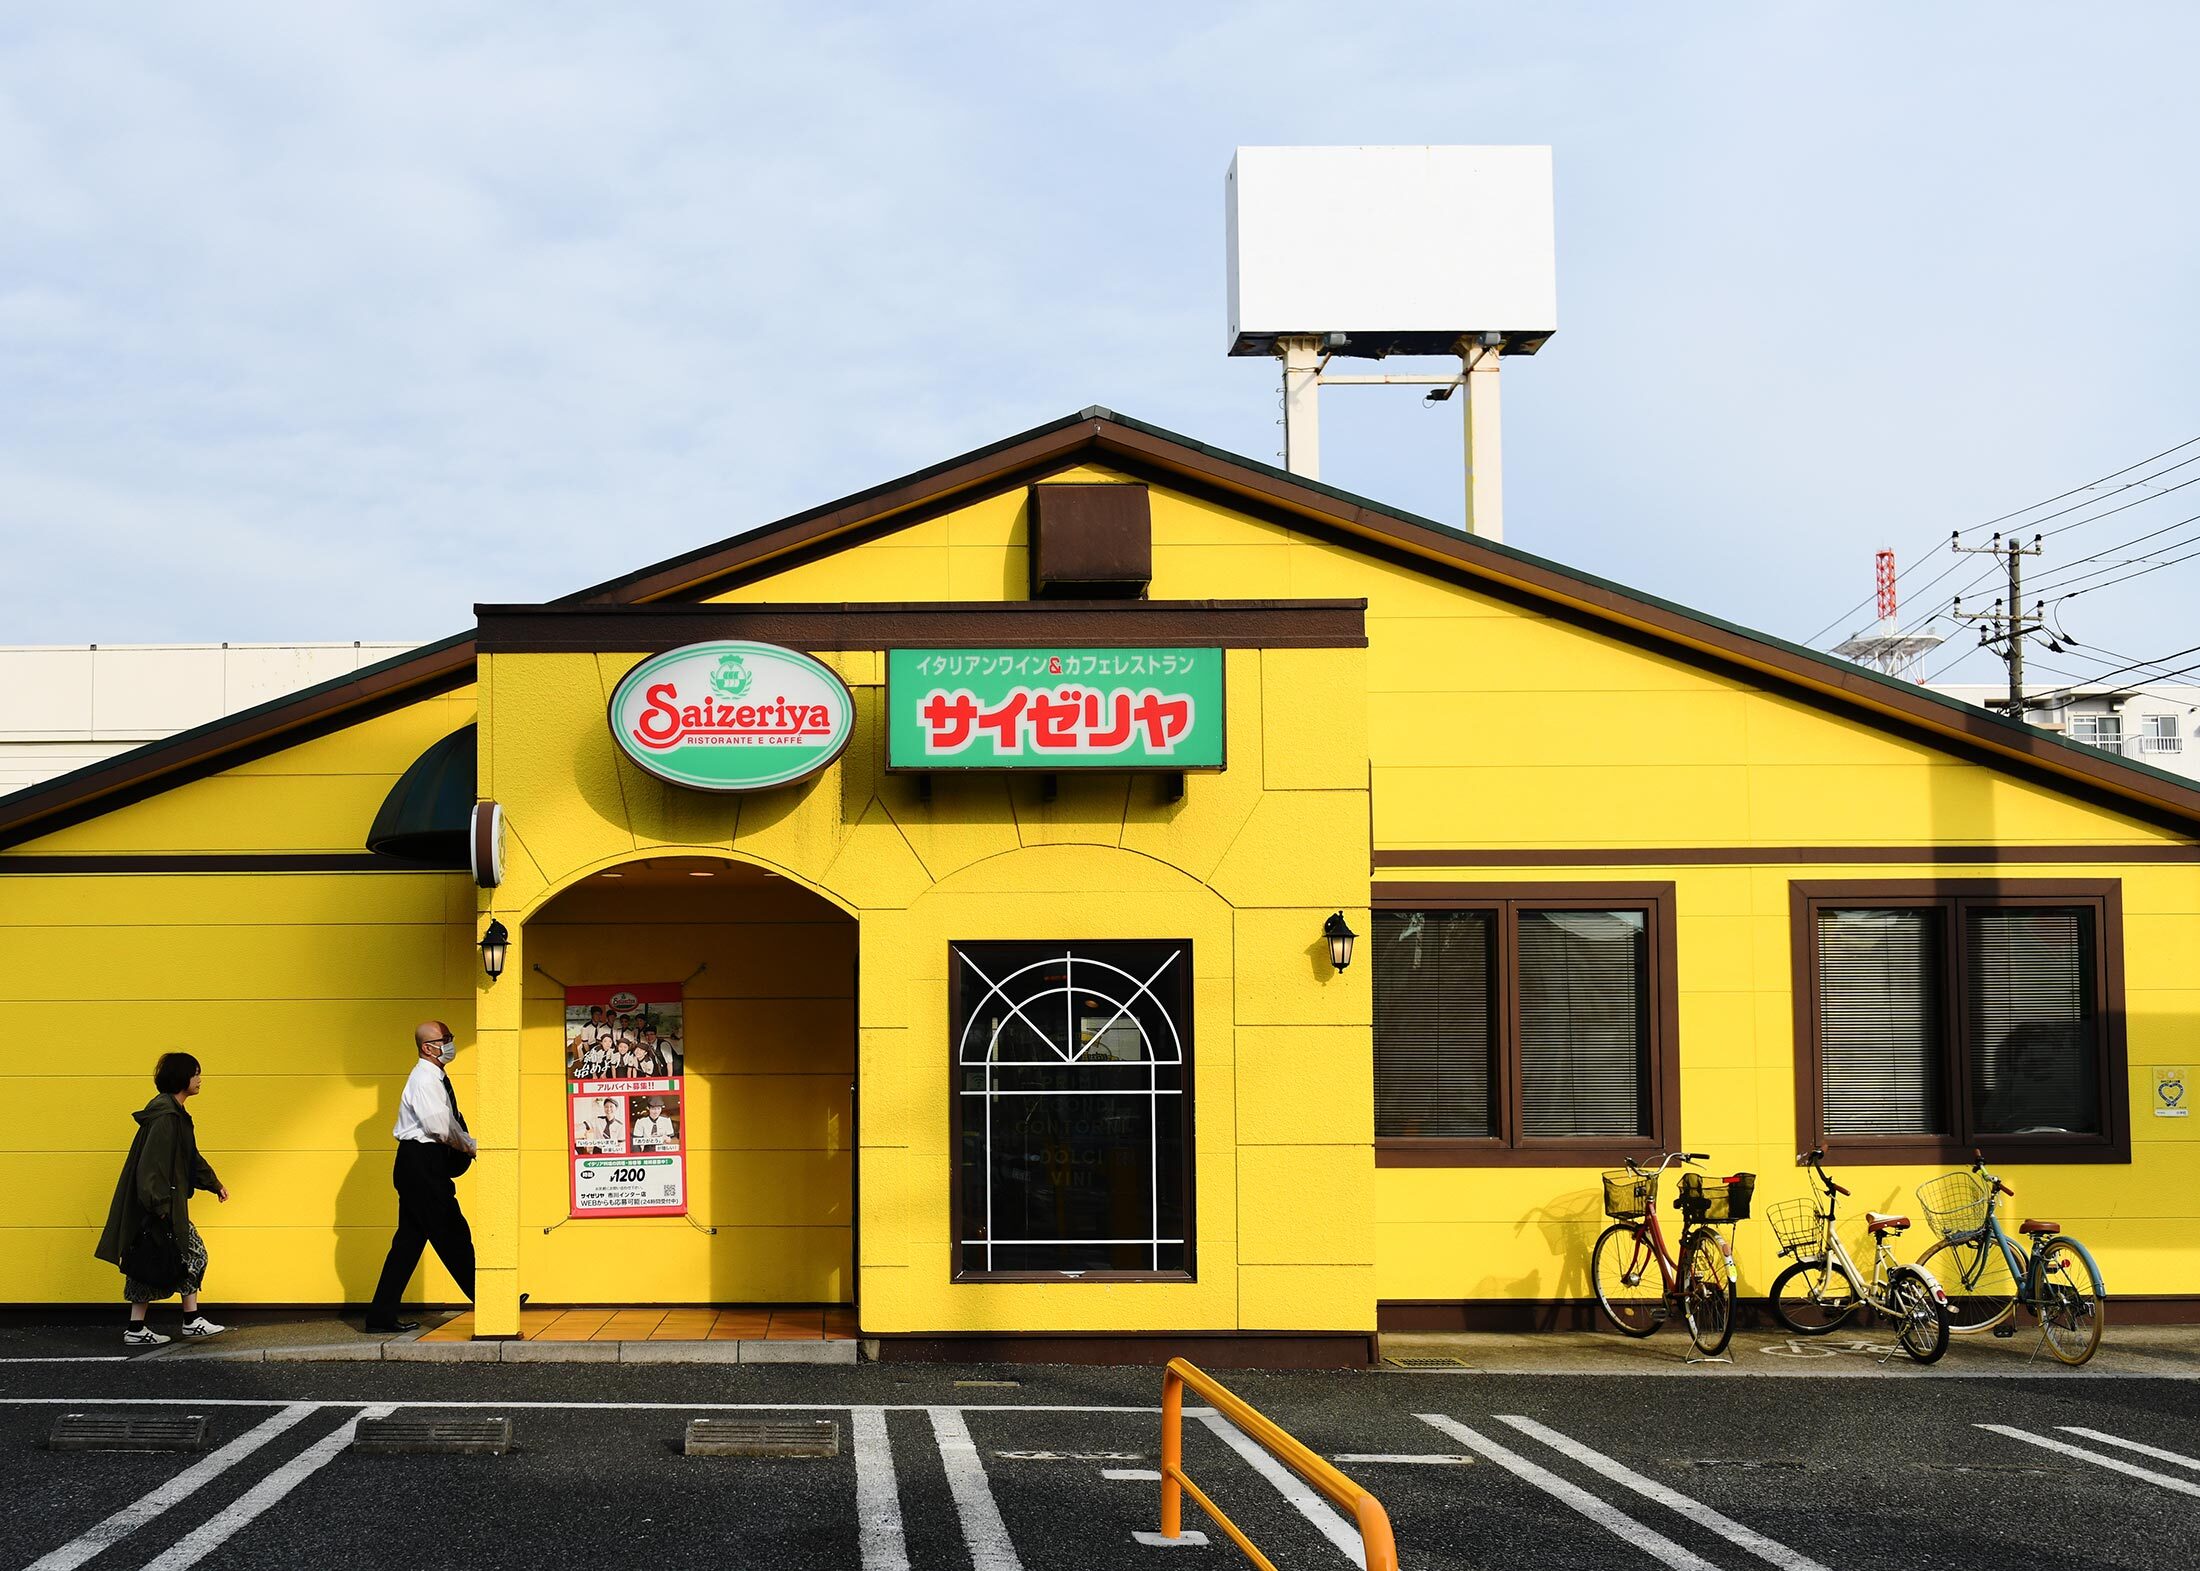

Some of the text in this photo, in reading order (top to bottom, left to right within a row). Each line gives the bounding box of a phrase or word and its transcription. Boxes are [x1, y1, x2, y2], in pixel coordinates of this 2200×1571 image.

[639, 683, 831, 742] Saizeriya
[687, 736, 753, 745] RISTORANTE
[758, 736, 764, 745] E
[922, 689, 1190, 750] サイゼリヤ
